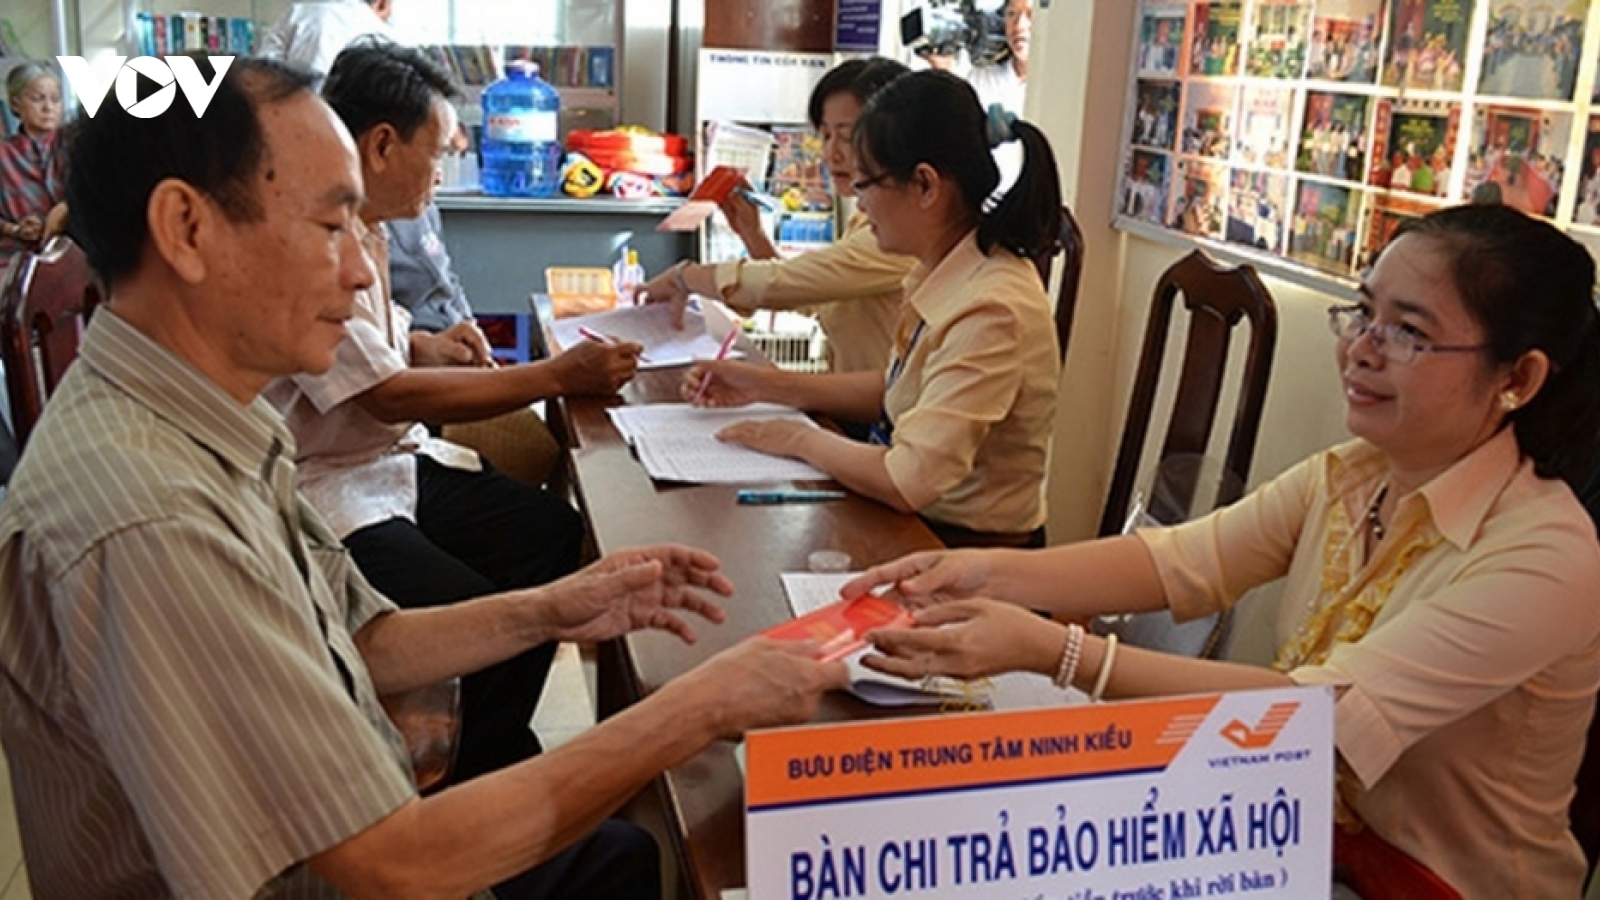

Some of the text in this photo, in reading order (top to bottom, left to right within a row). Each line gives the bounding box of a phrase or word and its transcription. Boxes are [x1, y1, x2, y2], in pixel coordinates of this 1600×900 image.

[899, 743, 973, 768] TRUNG
[980, 736, 1023, 761] TÂM
[1030, 733, 1079, 757] NINH
[1208, 754, 1270, 768] VIETNAM
[791, 786, 1300, 900] BÀN CHI TRẢ BẢO HIỂM XÃ HỘI
